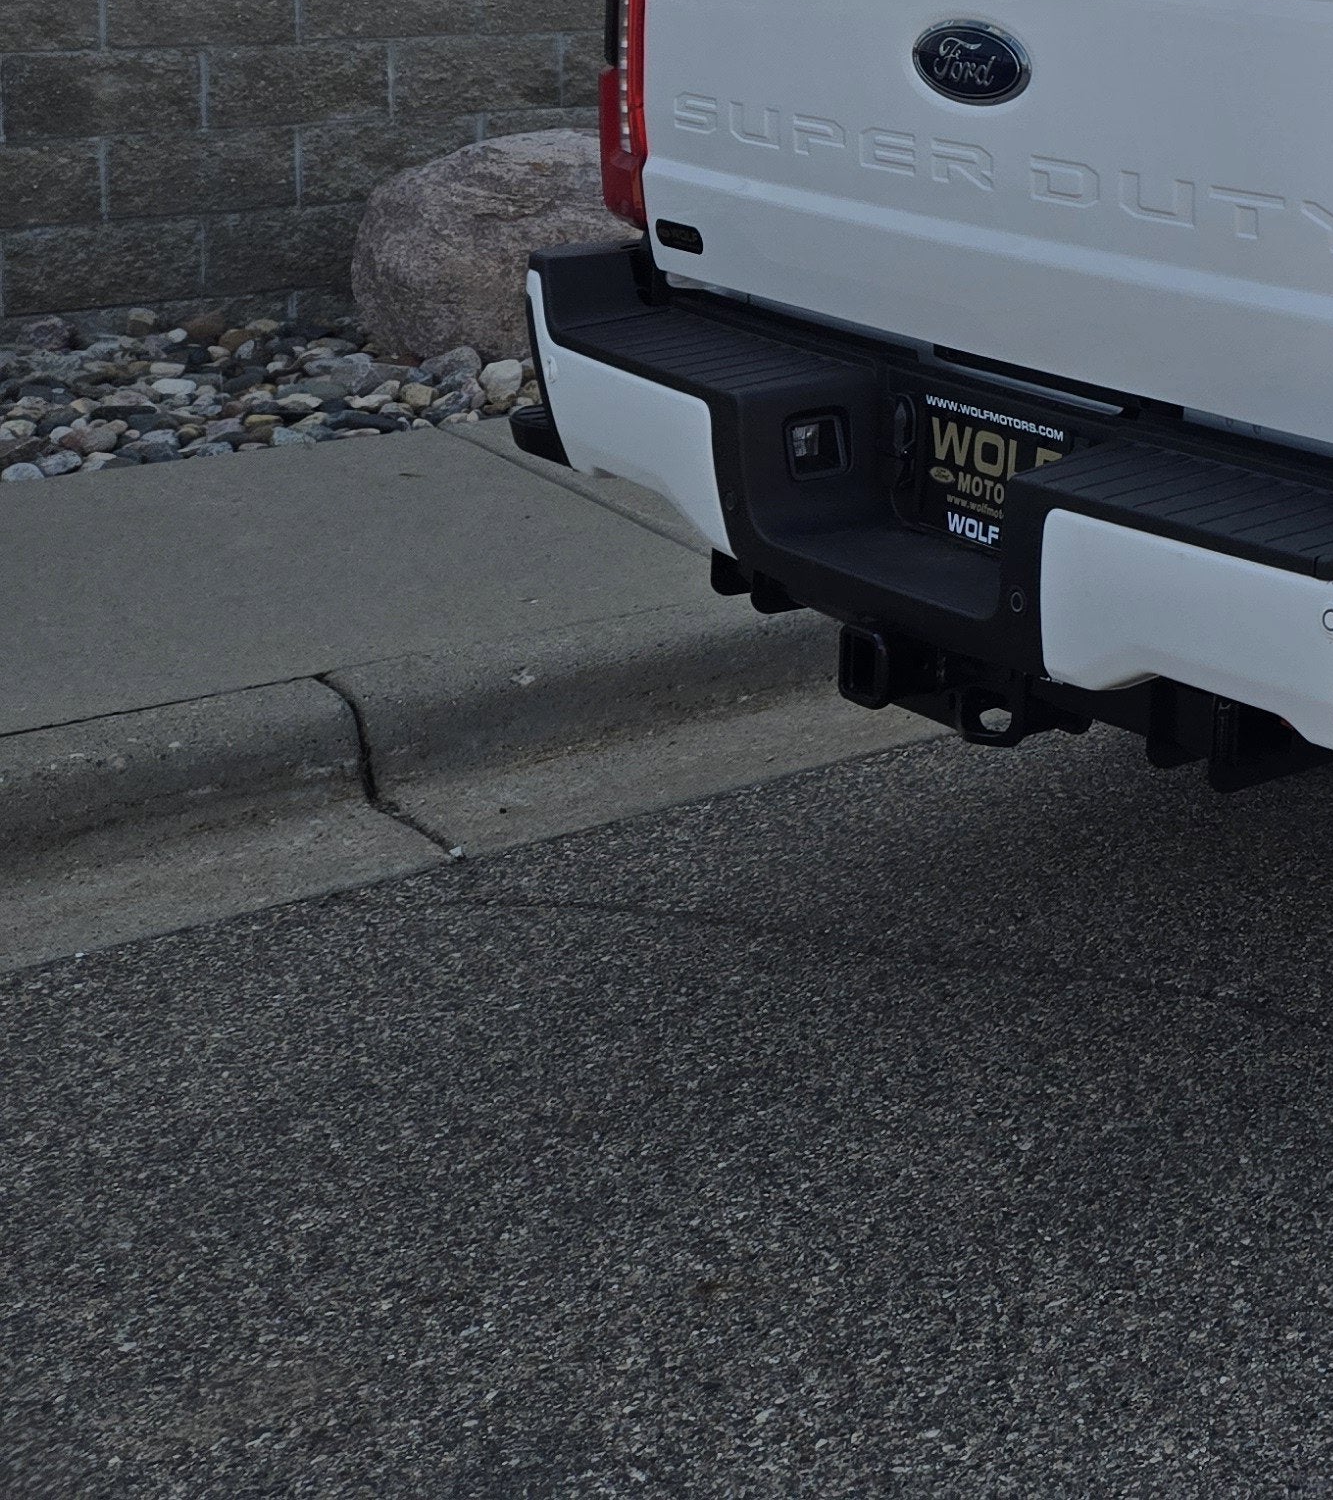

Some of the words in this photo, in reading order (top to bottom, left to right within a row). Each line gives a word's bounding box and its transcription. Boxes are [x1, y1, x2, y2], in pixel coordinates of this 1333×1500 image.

[933, 37, 997, 87] Ford
[673, 90, 995, 192] SUPER
[925, 393, 1064, 442] WWW.WOLFMOTORS.COM
[946, 511, 1000, 545] WOLF
